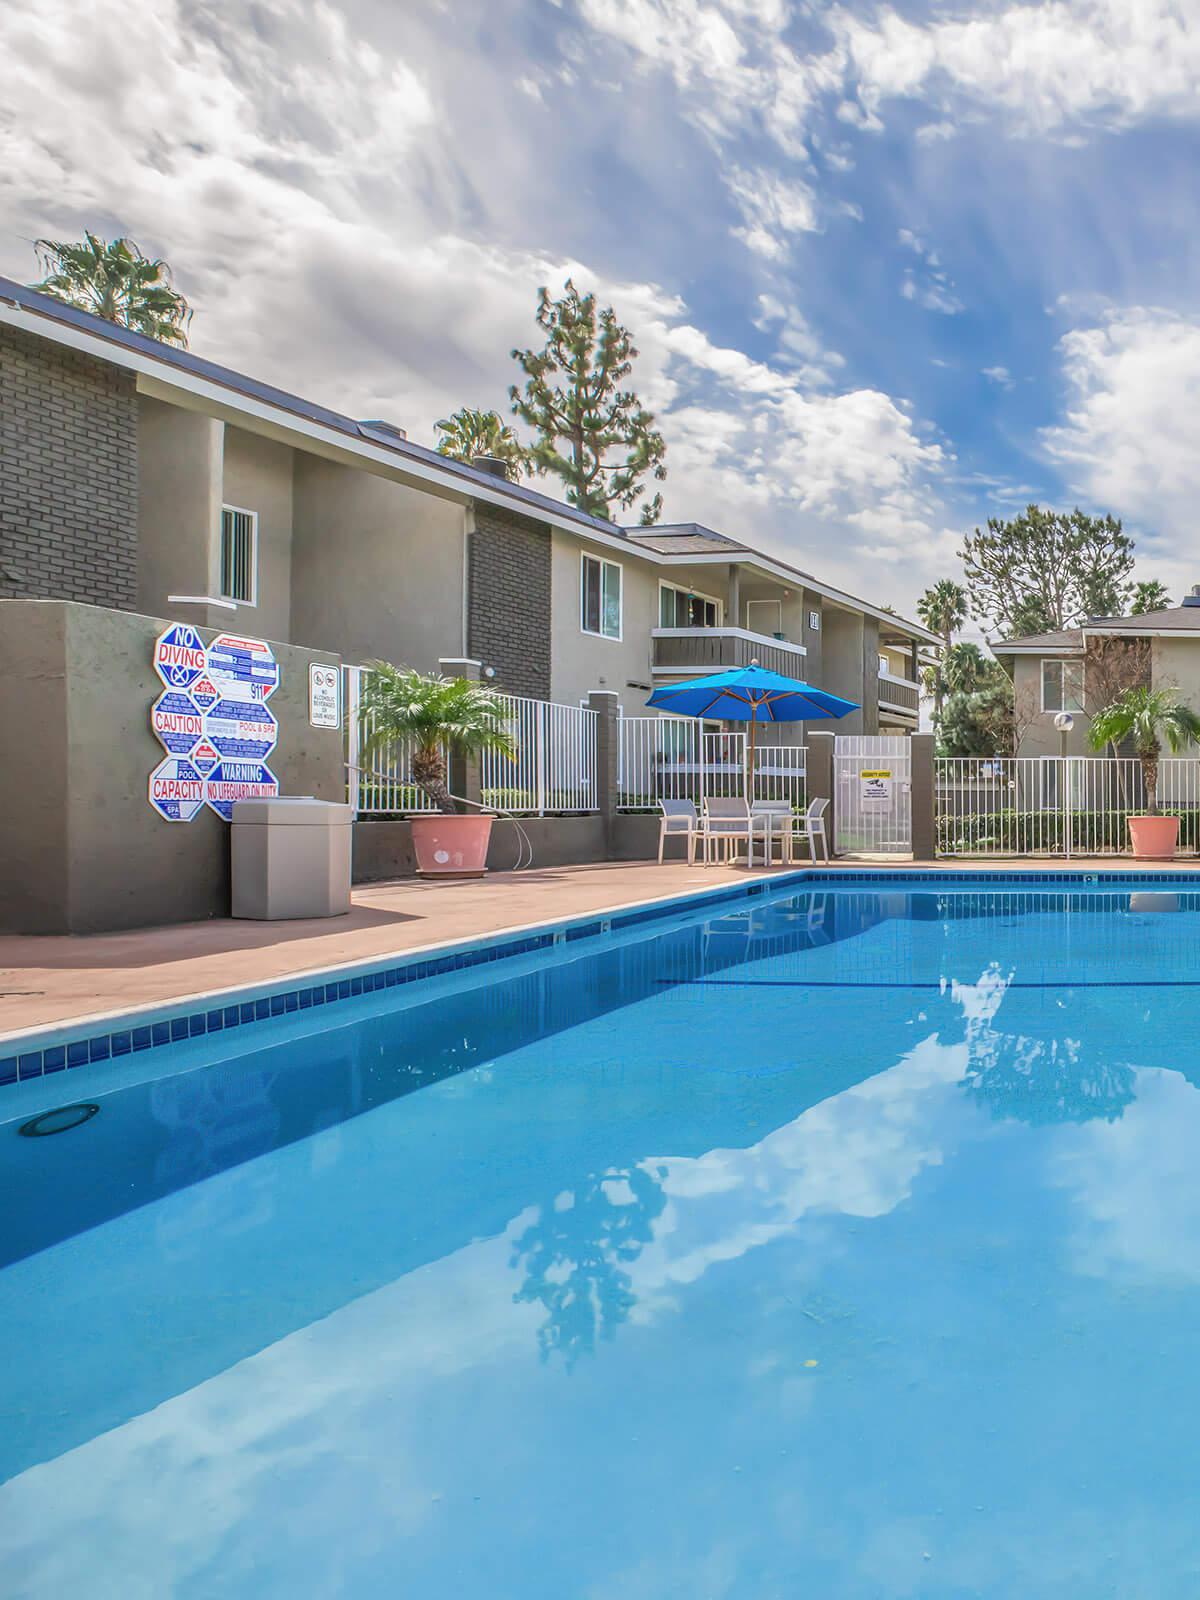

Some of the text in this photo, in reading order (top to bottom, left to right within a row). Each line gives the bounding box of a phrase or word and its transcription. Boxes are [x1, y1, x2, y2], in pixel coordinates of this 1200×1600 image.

[174, 627, 194, 647] NO
[159, 644, 205, 669] DIVING
[250, 682, 264, 700] 911
[155, 712, 202, 733] CAUTION
[240, 721, 256, 732] POOL
[178, 770, 198, 780] POOL
[221, 763, 263, 782] WARNING
[153, 780, 203, 799] CAPACITY
[208, 783, 217, 800] NO
[218, 783, 250, 800] LIFEGUARD
